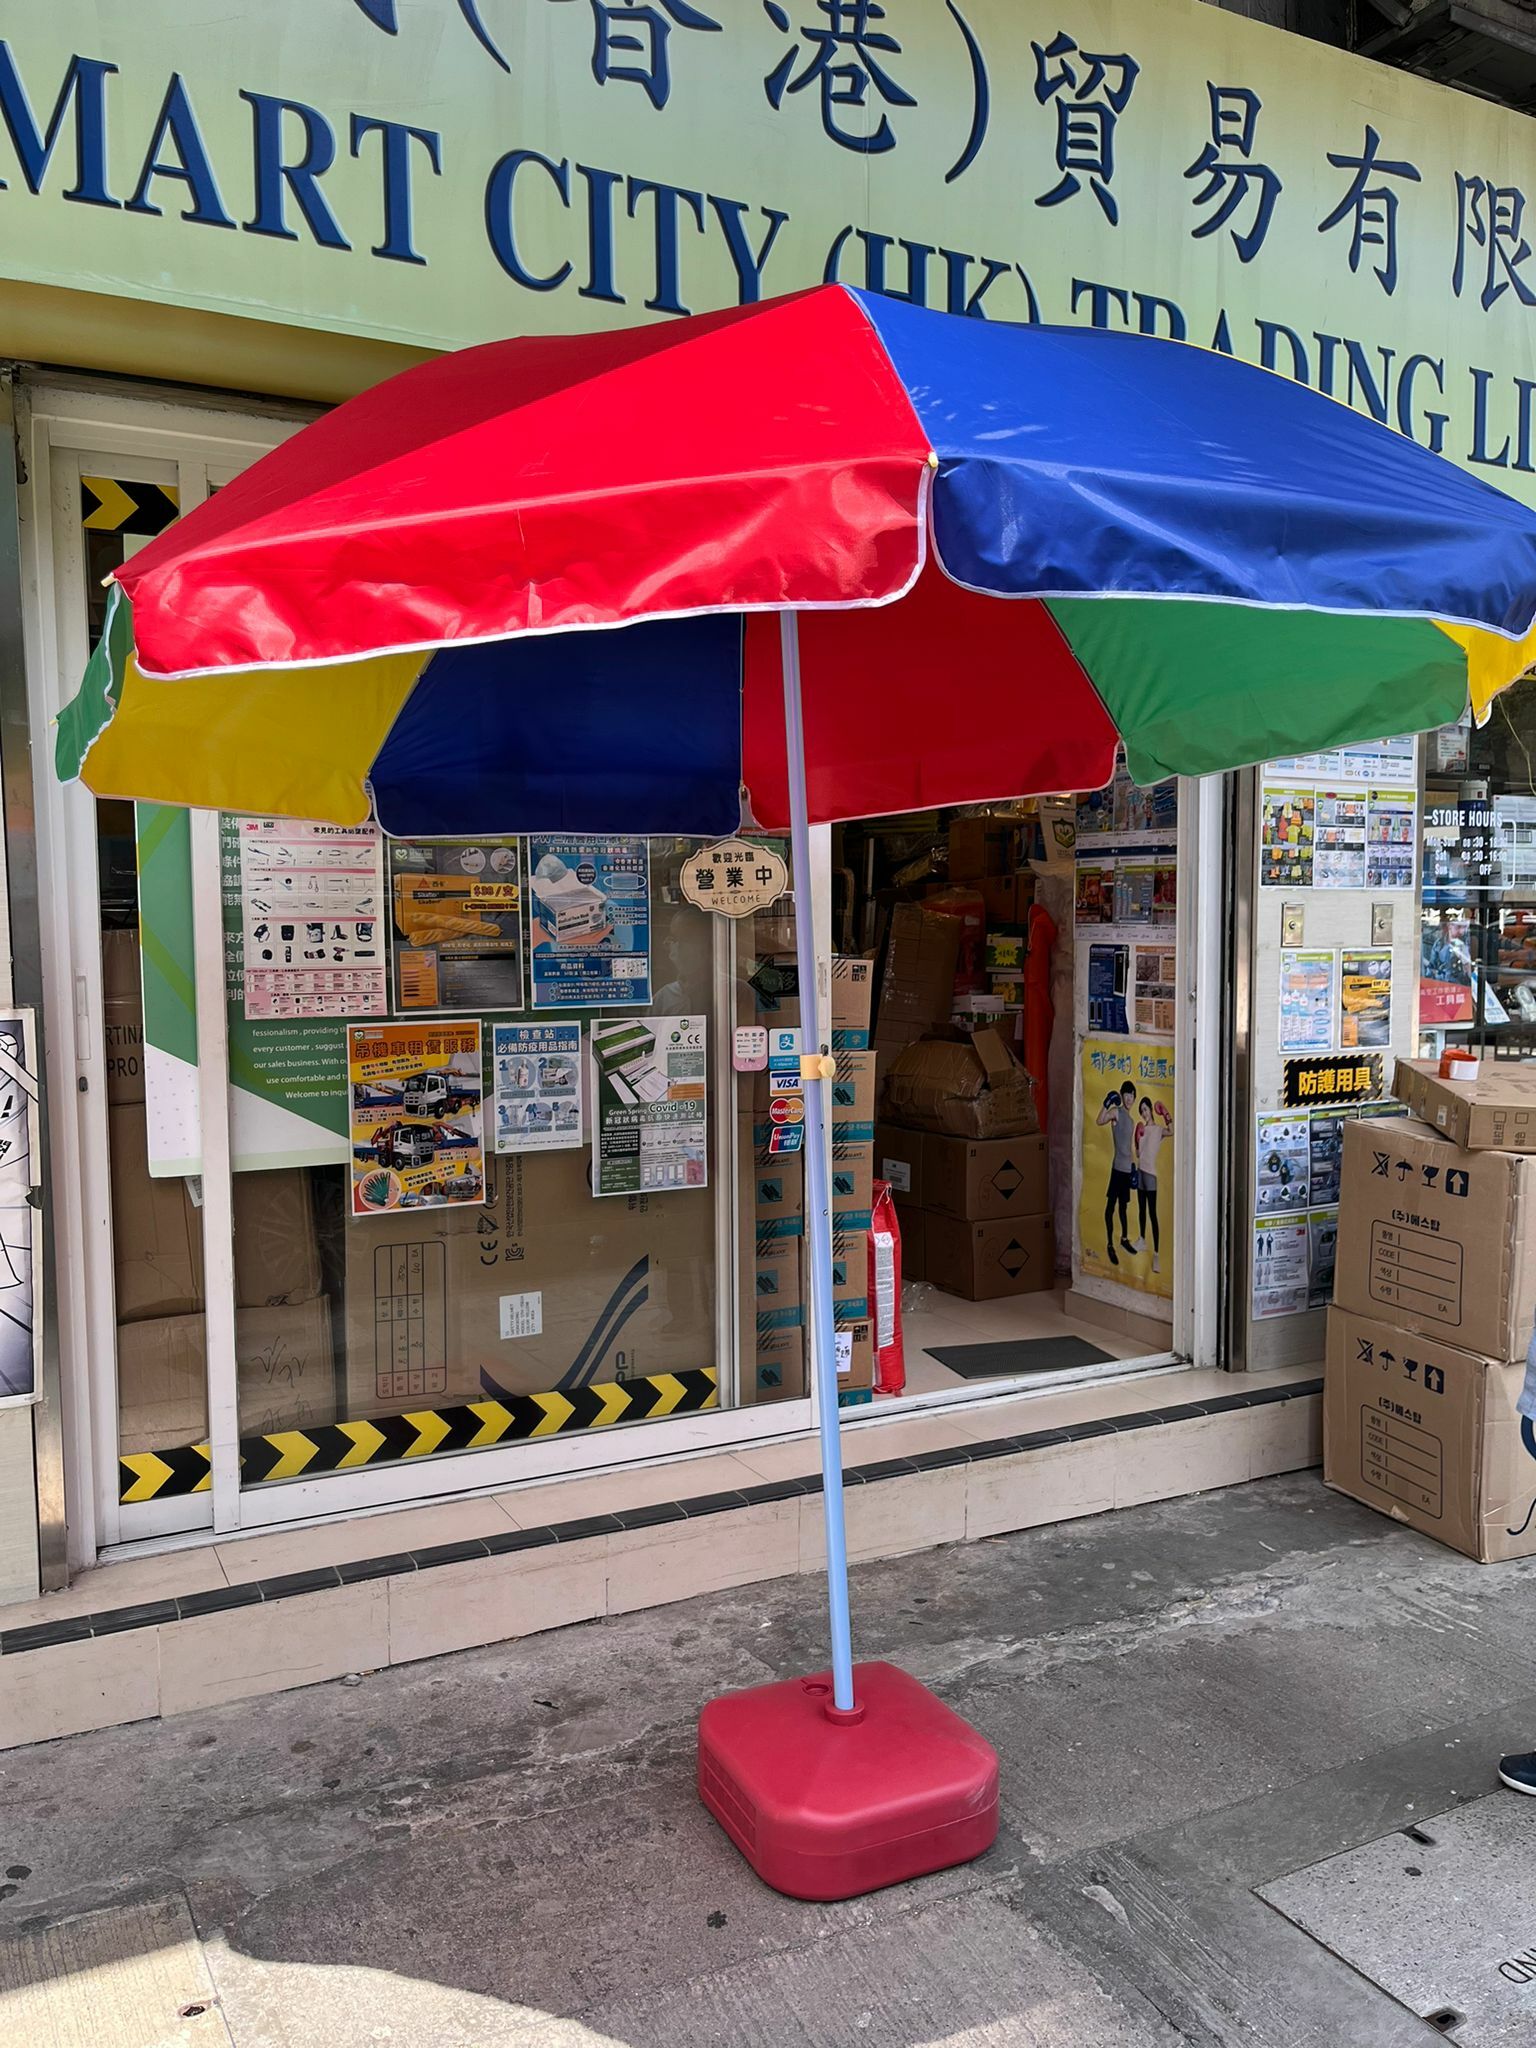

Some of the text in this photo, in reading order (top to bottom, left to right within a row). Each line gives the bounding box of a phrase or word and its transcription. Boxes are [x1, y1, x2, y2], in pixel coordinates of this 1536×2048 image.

[484, 149, 790, 316] CITY
[1432, 809, 1503, 828] STORE HOURS
[712, 851, 755, 864] 歡迎光臨
[1479, 864, 1492, 876] OFF
[695, 865, 773, 890] 營業中
[711, 894, 761, 905] WELCOME
[303, 1027, 339, 1036] providing
[519, 1029, 555, 1040] 檢查站
[253, 1046, 275, 1054] every
[275, 1044, 310, 1052] customer
[497, 1040, 578, 1053] 必備防疫用品指南
[267, 1060, 286, 1068] sales
[499, 1057, 548, 1071] 1 2
[280, 1074, 326, 1083] comfortable
[776, 1079, 799, 1088] VISA
[1298, 1067, 1372, 1096] 防護用具
[285, 1090, 320, 1099] Welcome
[649, 1103, 678, 1113] Covid
[771, 1106, 804, 1115] MasterCard
[773, 1132, 801, 1141] UnionPay
[1378, 1247, 1395, 1260] CODE
[1437, 1303, 1448, 1314] EA
